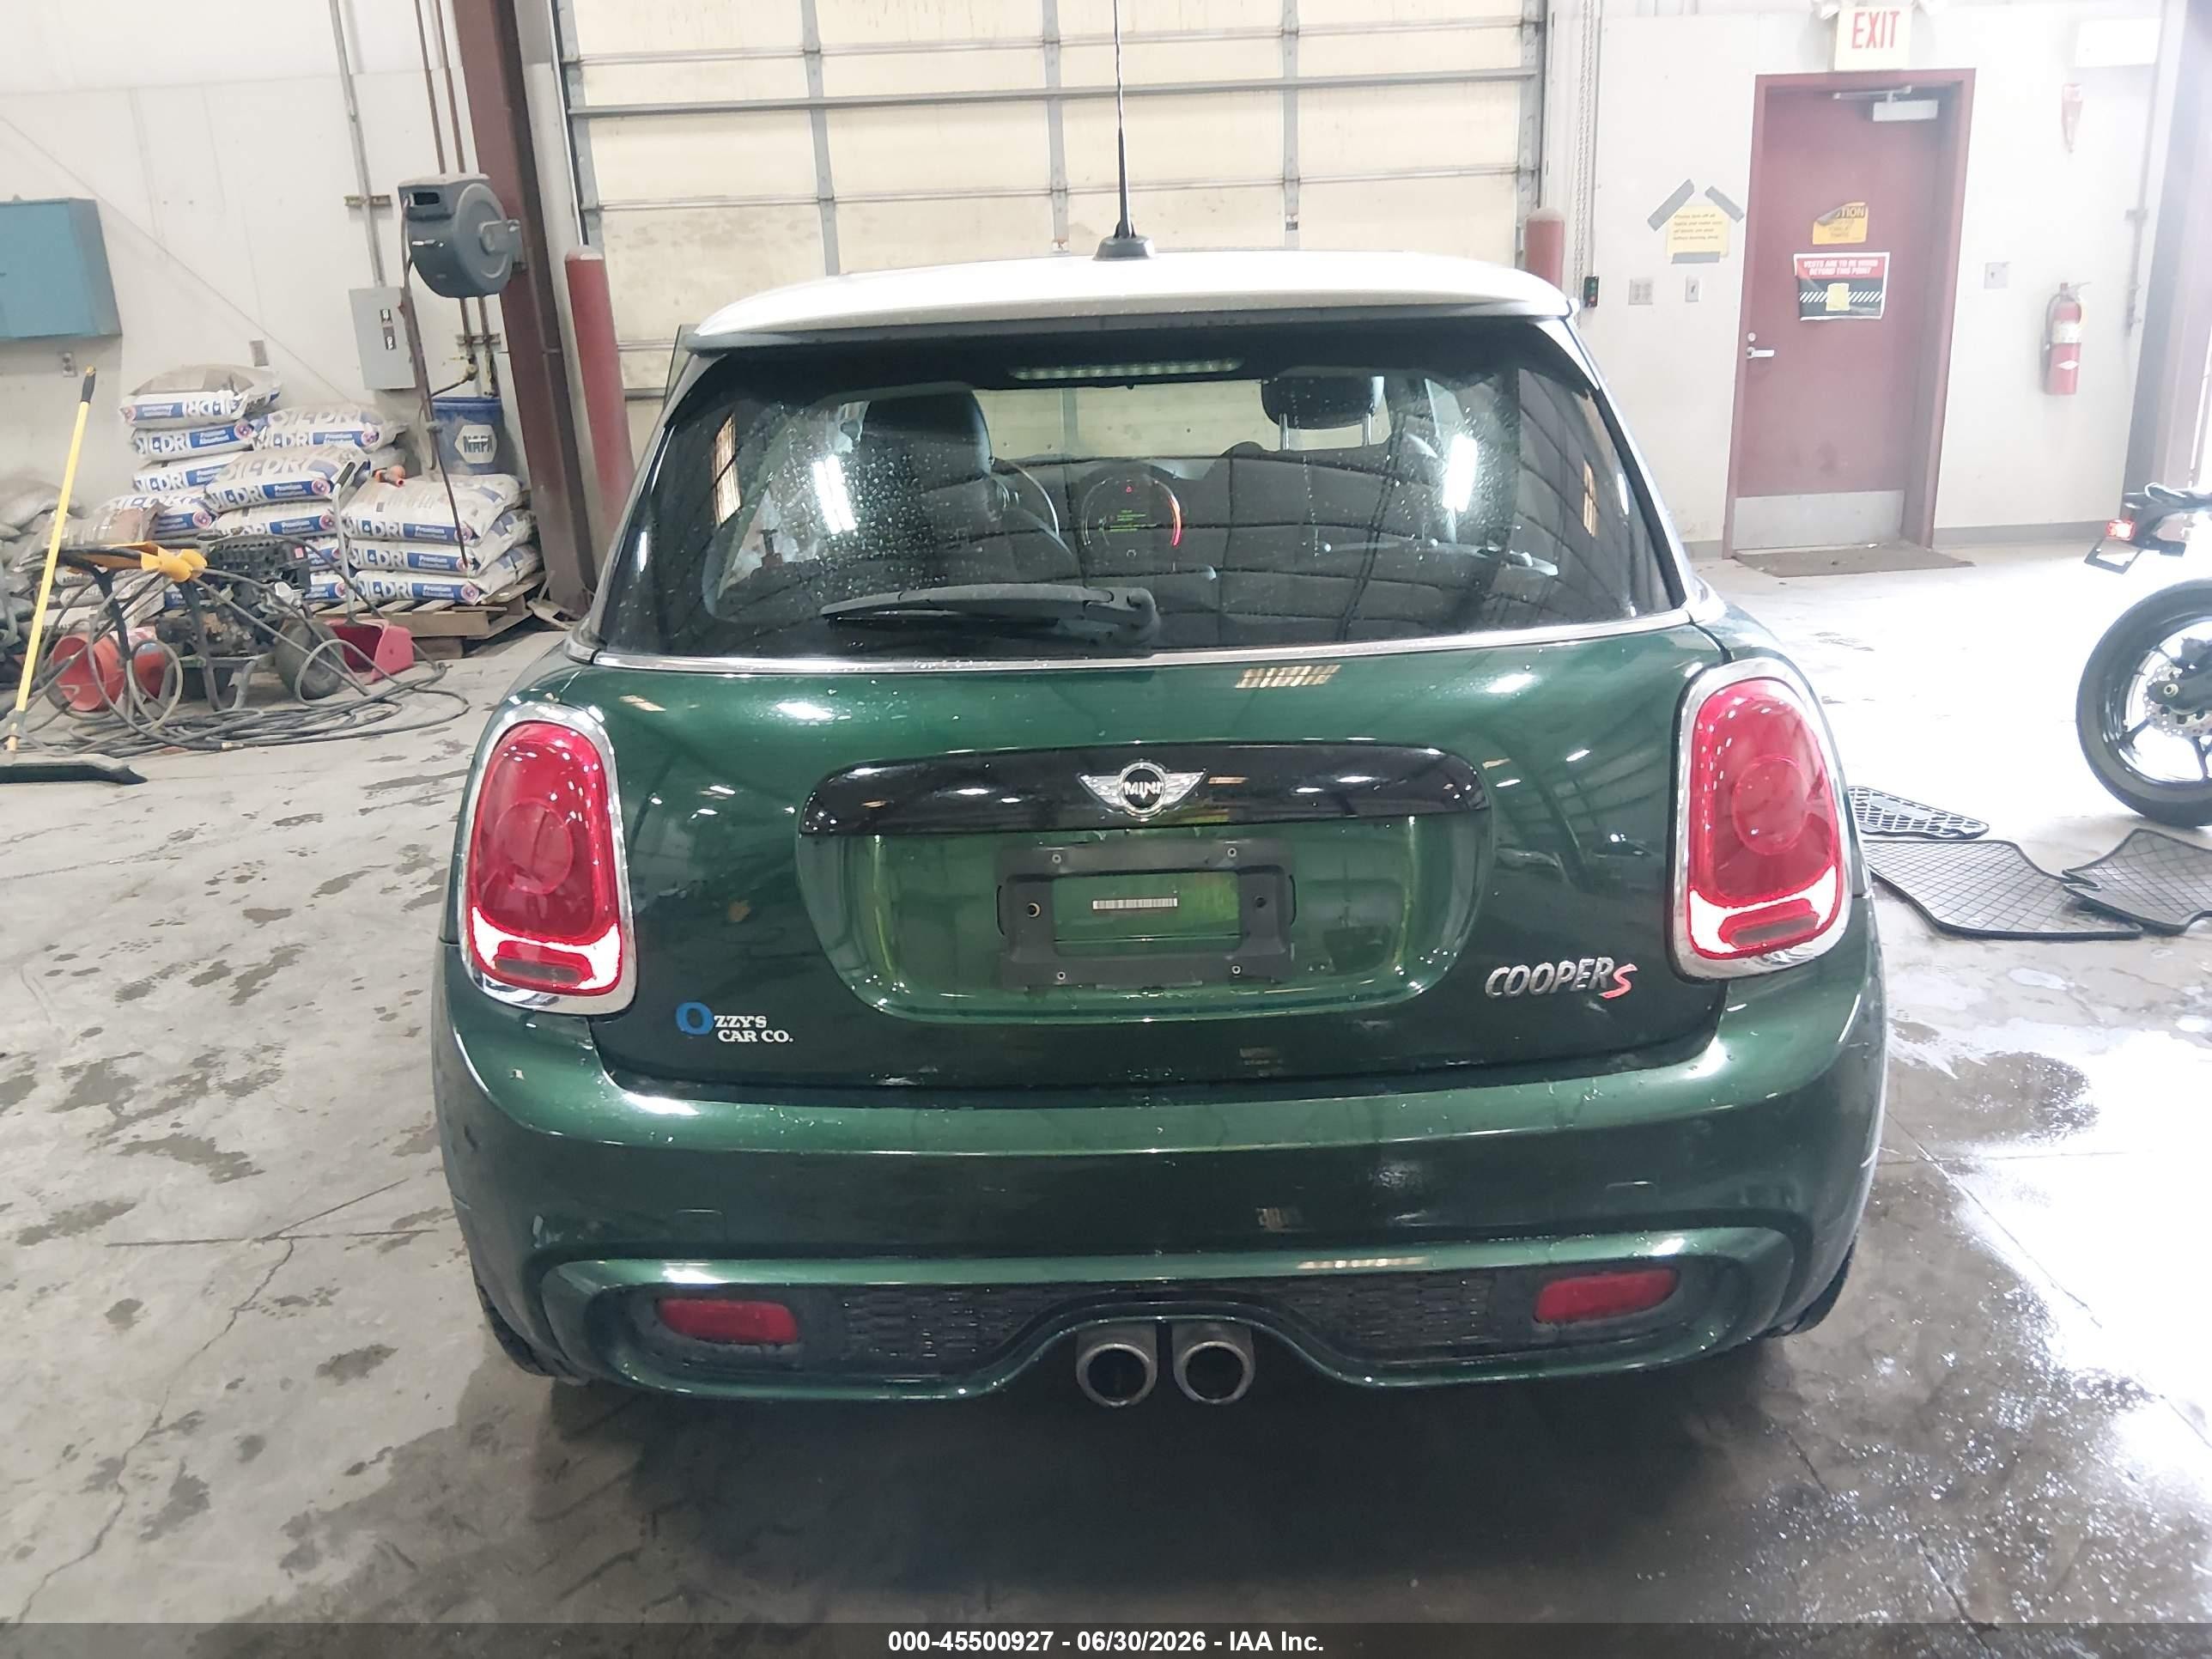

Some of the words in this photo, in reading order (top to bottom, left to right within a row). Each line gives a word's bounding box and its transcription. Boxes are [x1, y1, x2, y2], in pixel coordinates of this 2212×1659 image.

[1851, 10, 1900, 49] EXIT
[463, 434, 494, 453] NAPA
[1124, 781, 1163, 799] MINI
[1485, 957, 1614, 998] COOPER
[1597, 963, 1638, 999] S
[717, 1030, 758, 1042] CAR
[761, 1030, 793, 1042] CO.
